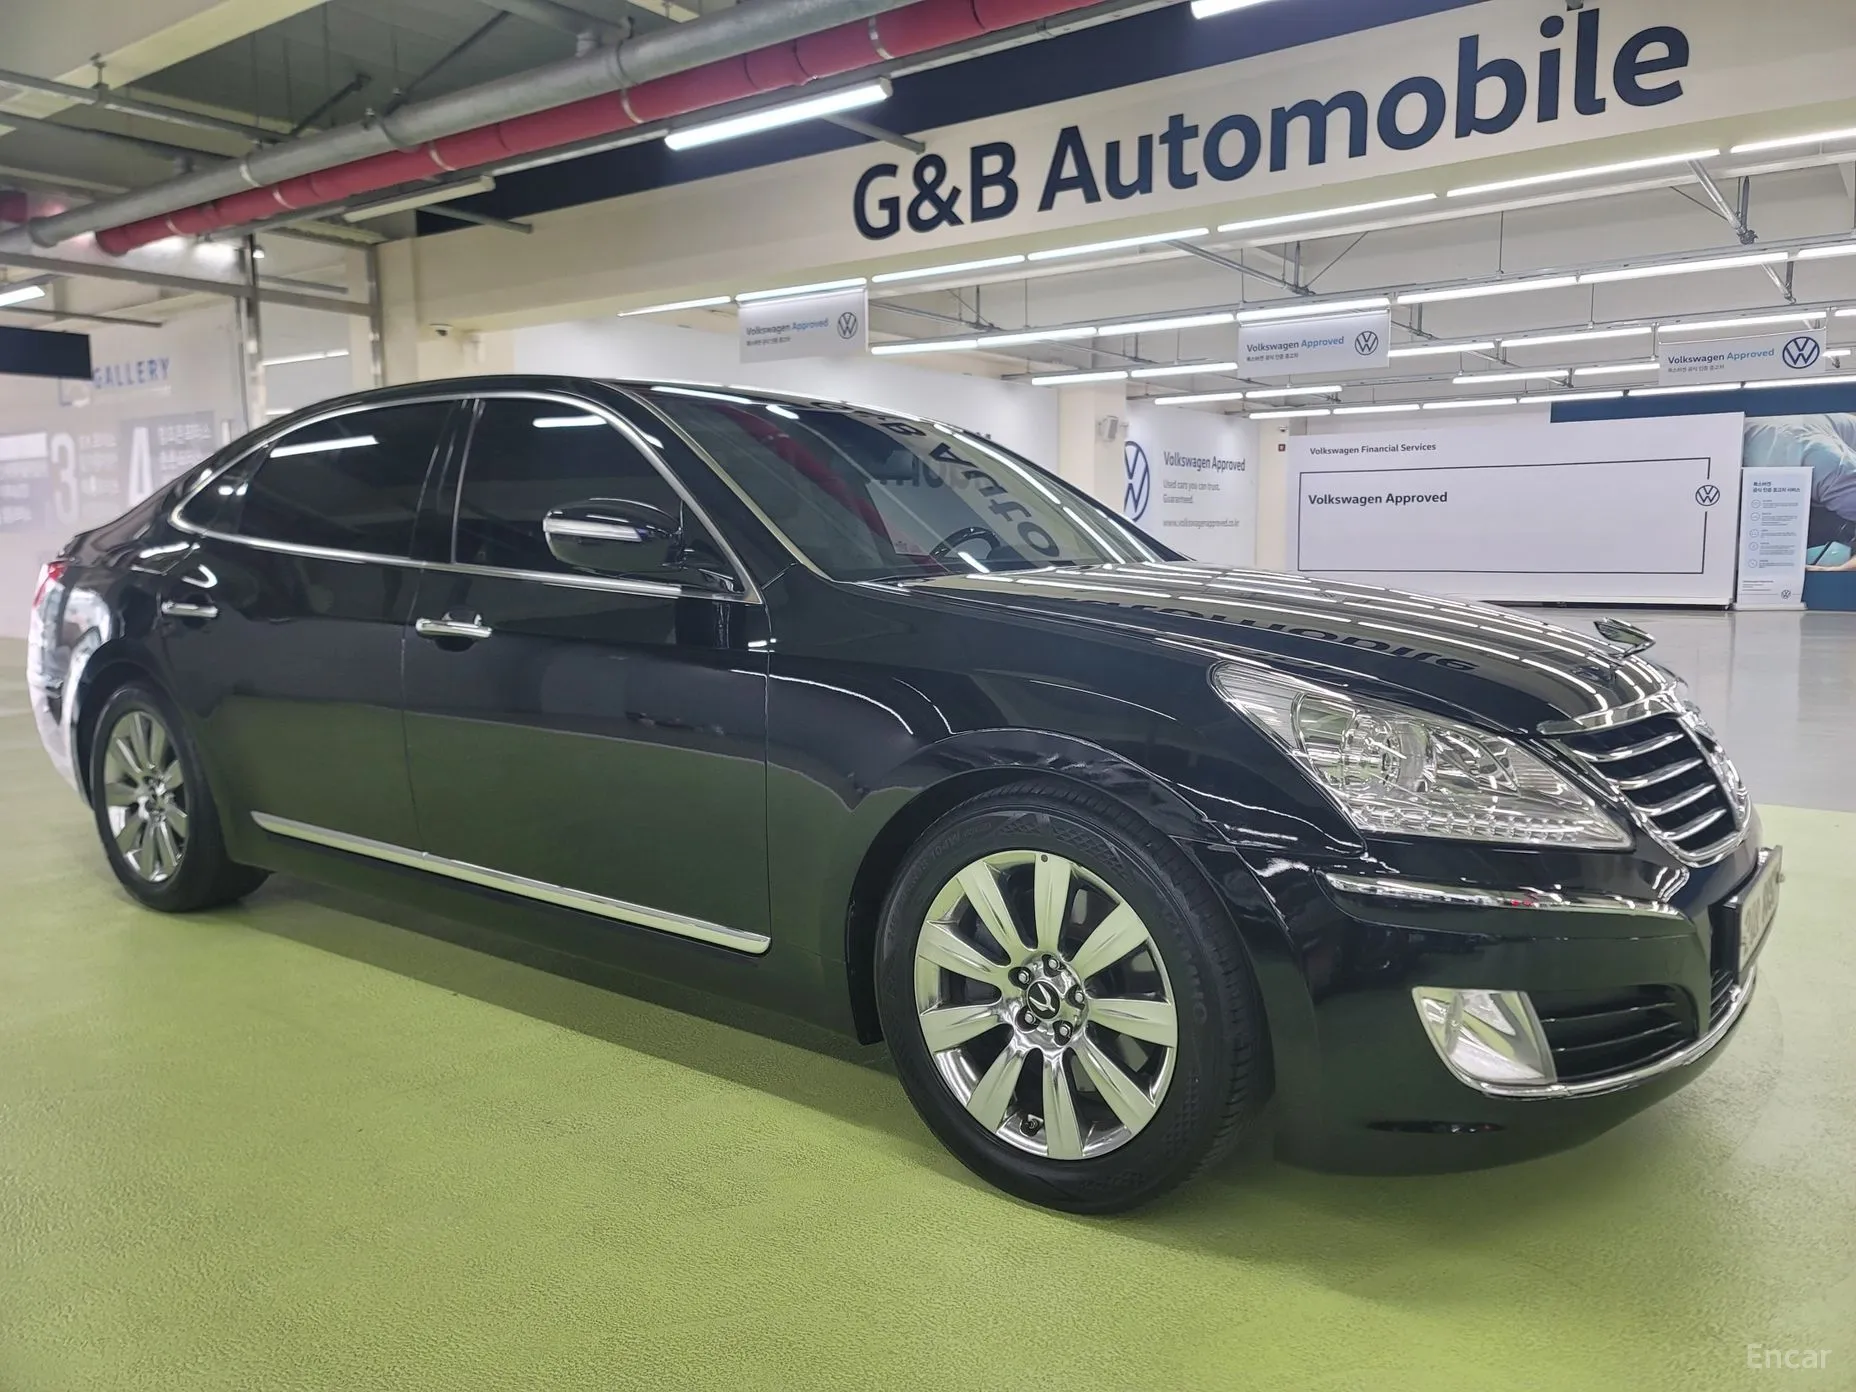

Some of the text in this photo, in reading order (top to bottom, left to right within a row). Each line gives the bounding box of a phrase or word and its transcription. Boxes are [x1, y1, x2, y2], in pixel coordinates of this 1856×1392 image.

[853, 8, 1692, 241] G&B Automobile
[746, 318, 829, 336] Volkswagen Approved
[1246, 336, 1345, 353] Volkswagen Approved
[1667, 348, 1775, 365] Volkswagen Approved
[1309, 442, 1437, 456] Volkswagen Financial Services
[1163, 451, 1246, 473] Volkswagen Approved
[50, 432, 79, 526] 3
[1163, 480, 1176, 489] Used
[1177, 481, 1188, 490] cars
[1188, 483, 1198, 492] you
[1308, 491, 1448, 507] Volkswagen Approved
